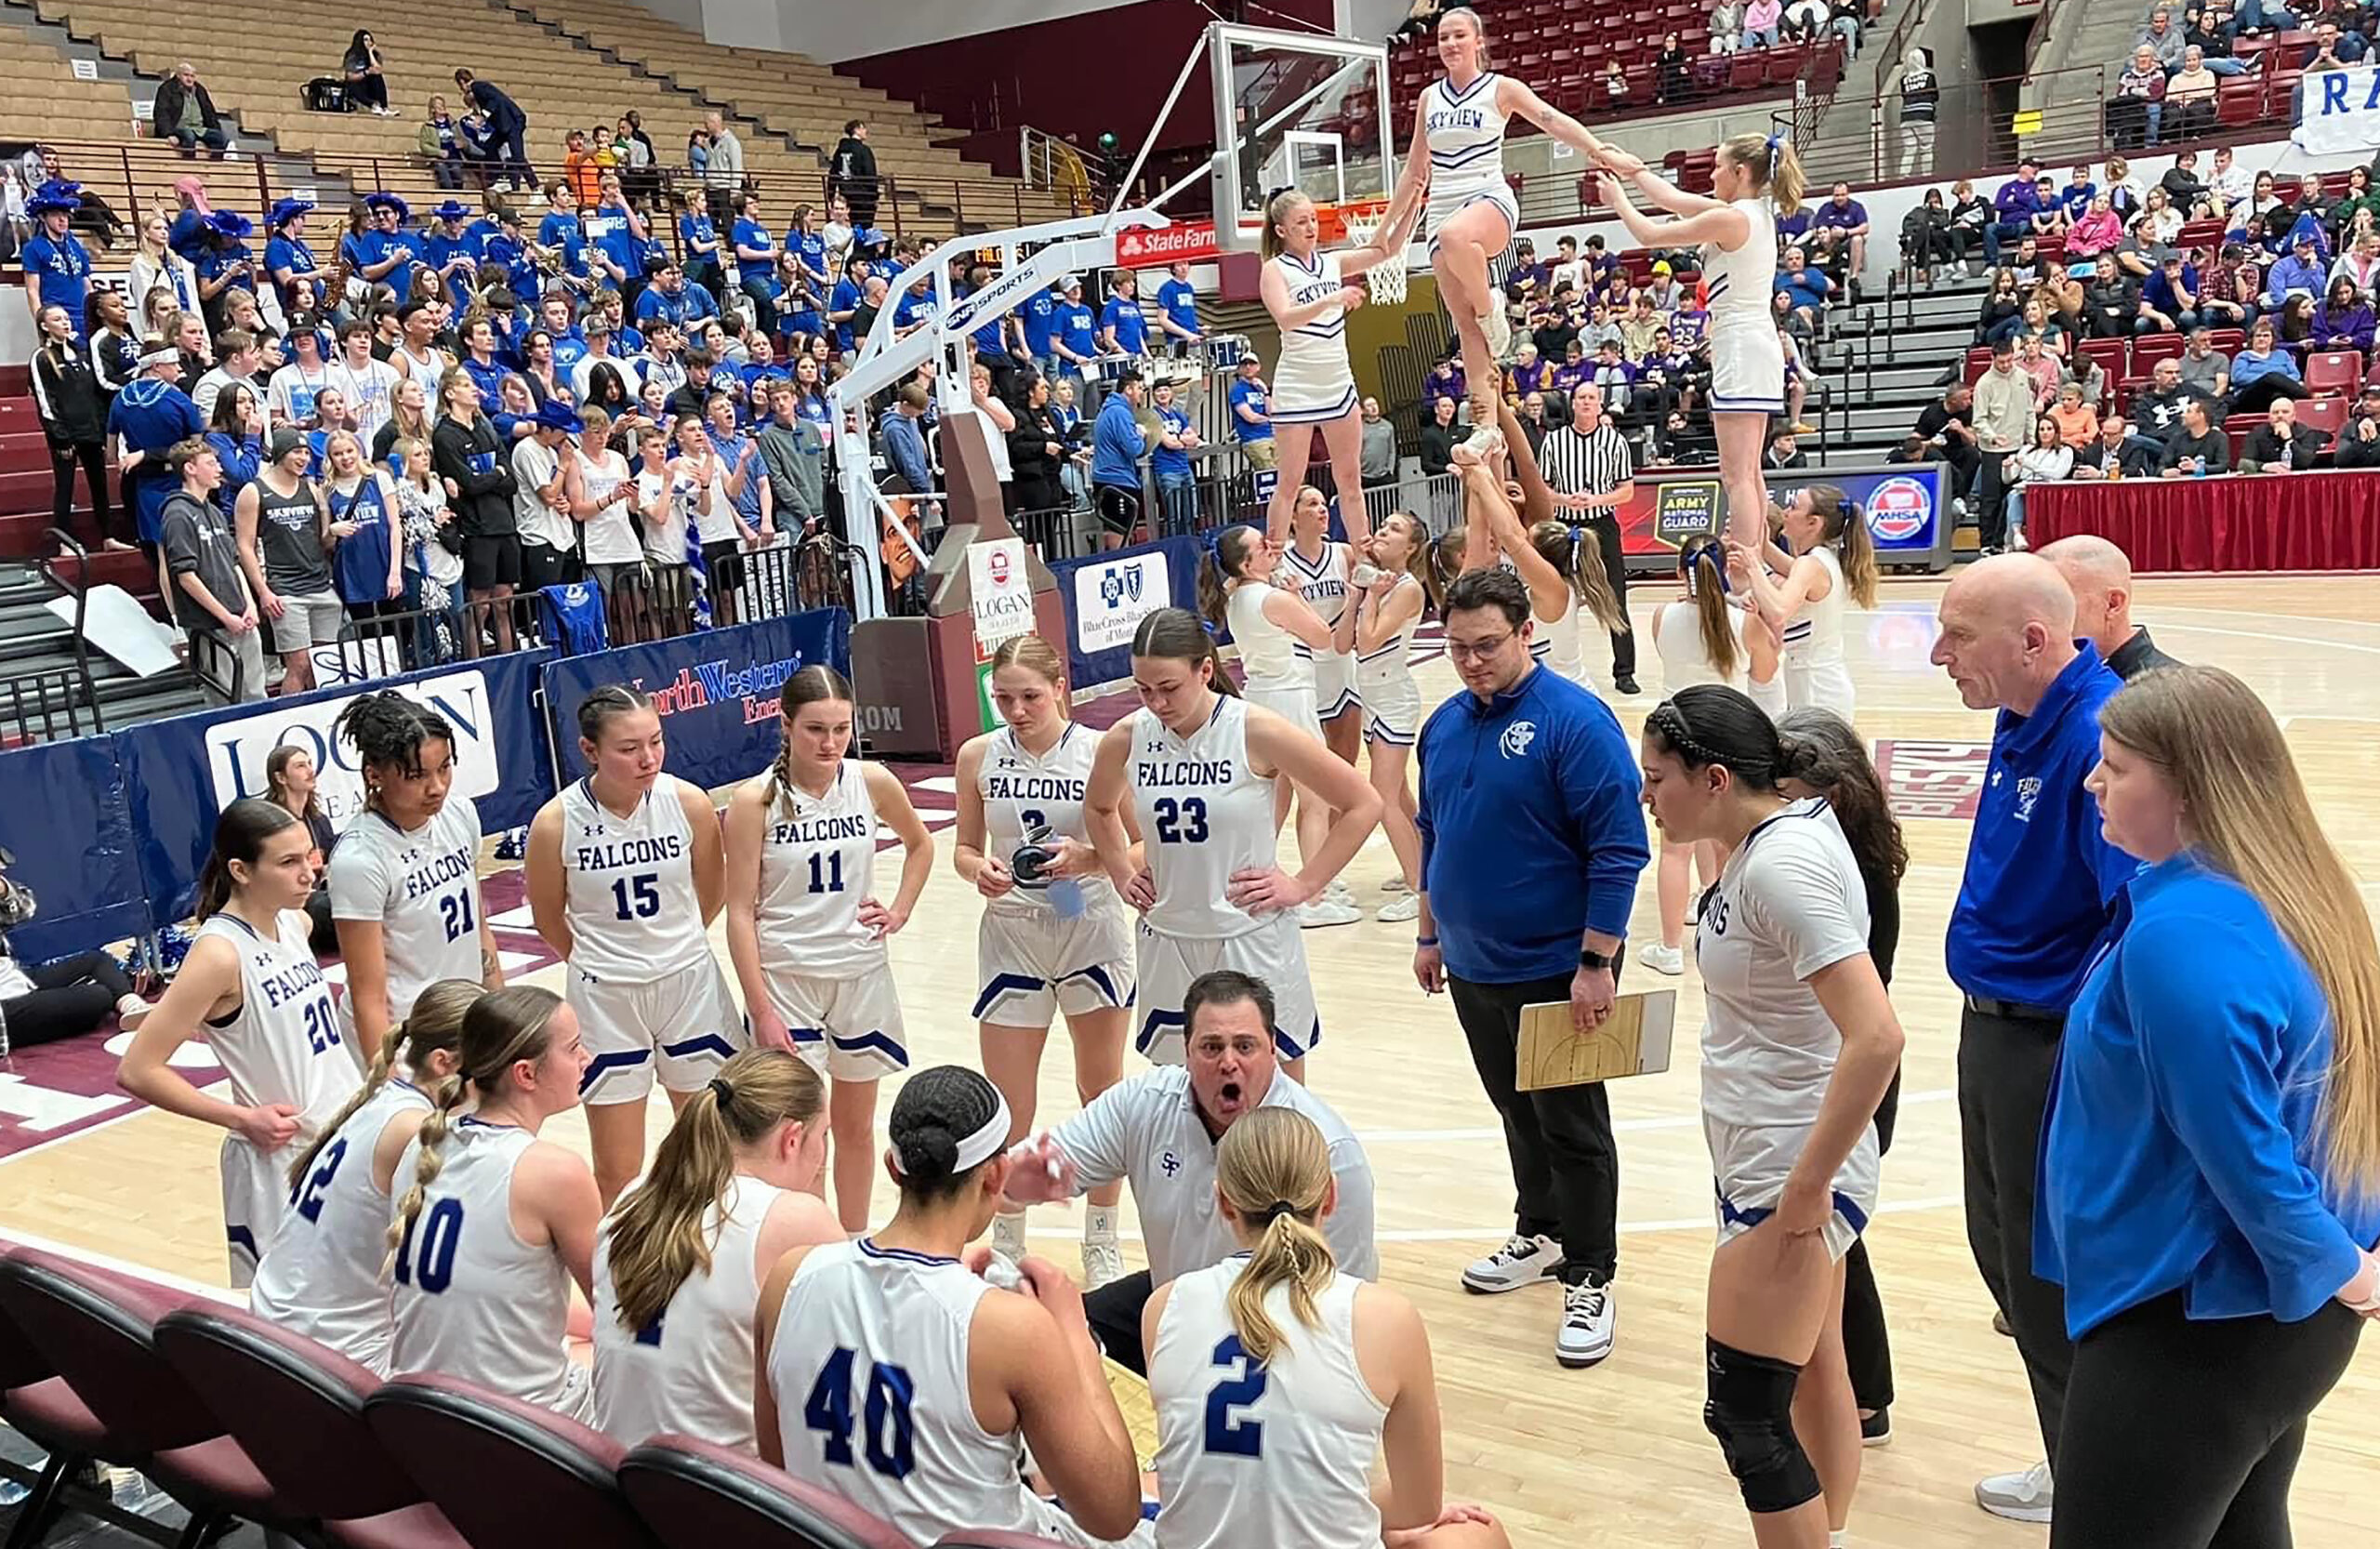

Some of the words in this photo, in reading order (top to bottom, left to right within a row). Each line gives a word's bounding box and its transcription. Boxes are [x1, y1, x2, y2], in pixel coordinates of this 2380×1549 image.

[978, 267, 1034, 309] SPORTS
[1297, 282, 1340, 305] SKYVIE
[1663, 516, 1709, 528] GUARD
[1665, 496, 1710, 510] ARMY
[1300, 579, 1346, 602] KYVIEW
[632, 656, 800, 717] orthWestern
[220, 684, 477, 802] LON
[989, 777, 1085, 801] FALCONS
[1138, 760, 1233, 788] FALCONS
[774, 814, 866, 844] FALCONS
[1154, 797, 1210, 844] 23
[577, 835, 681, 871] FALCONS
[808, 850, 845, 894] 11
[440, 887, 474, 944] 21
[611, 873, 660, 920] 15
[261, 960, 324, 1008] FALCON
[304, 994, 341, 1056] 20
[290, 1136, 348, 1226] 2
[1162, 1152, 1180, 1177] SF
[804, 1345, 916, 1480] 40
[1203, 1332, 1269, 1459] 2
